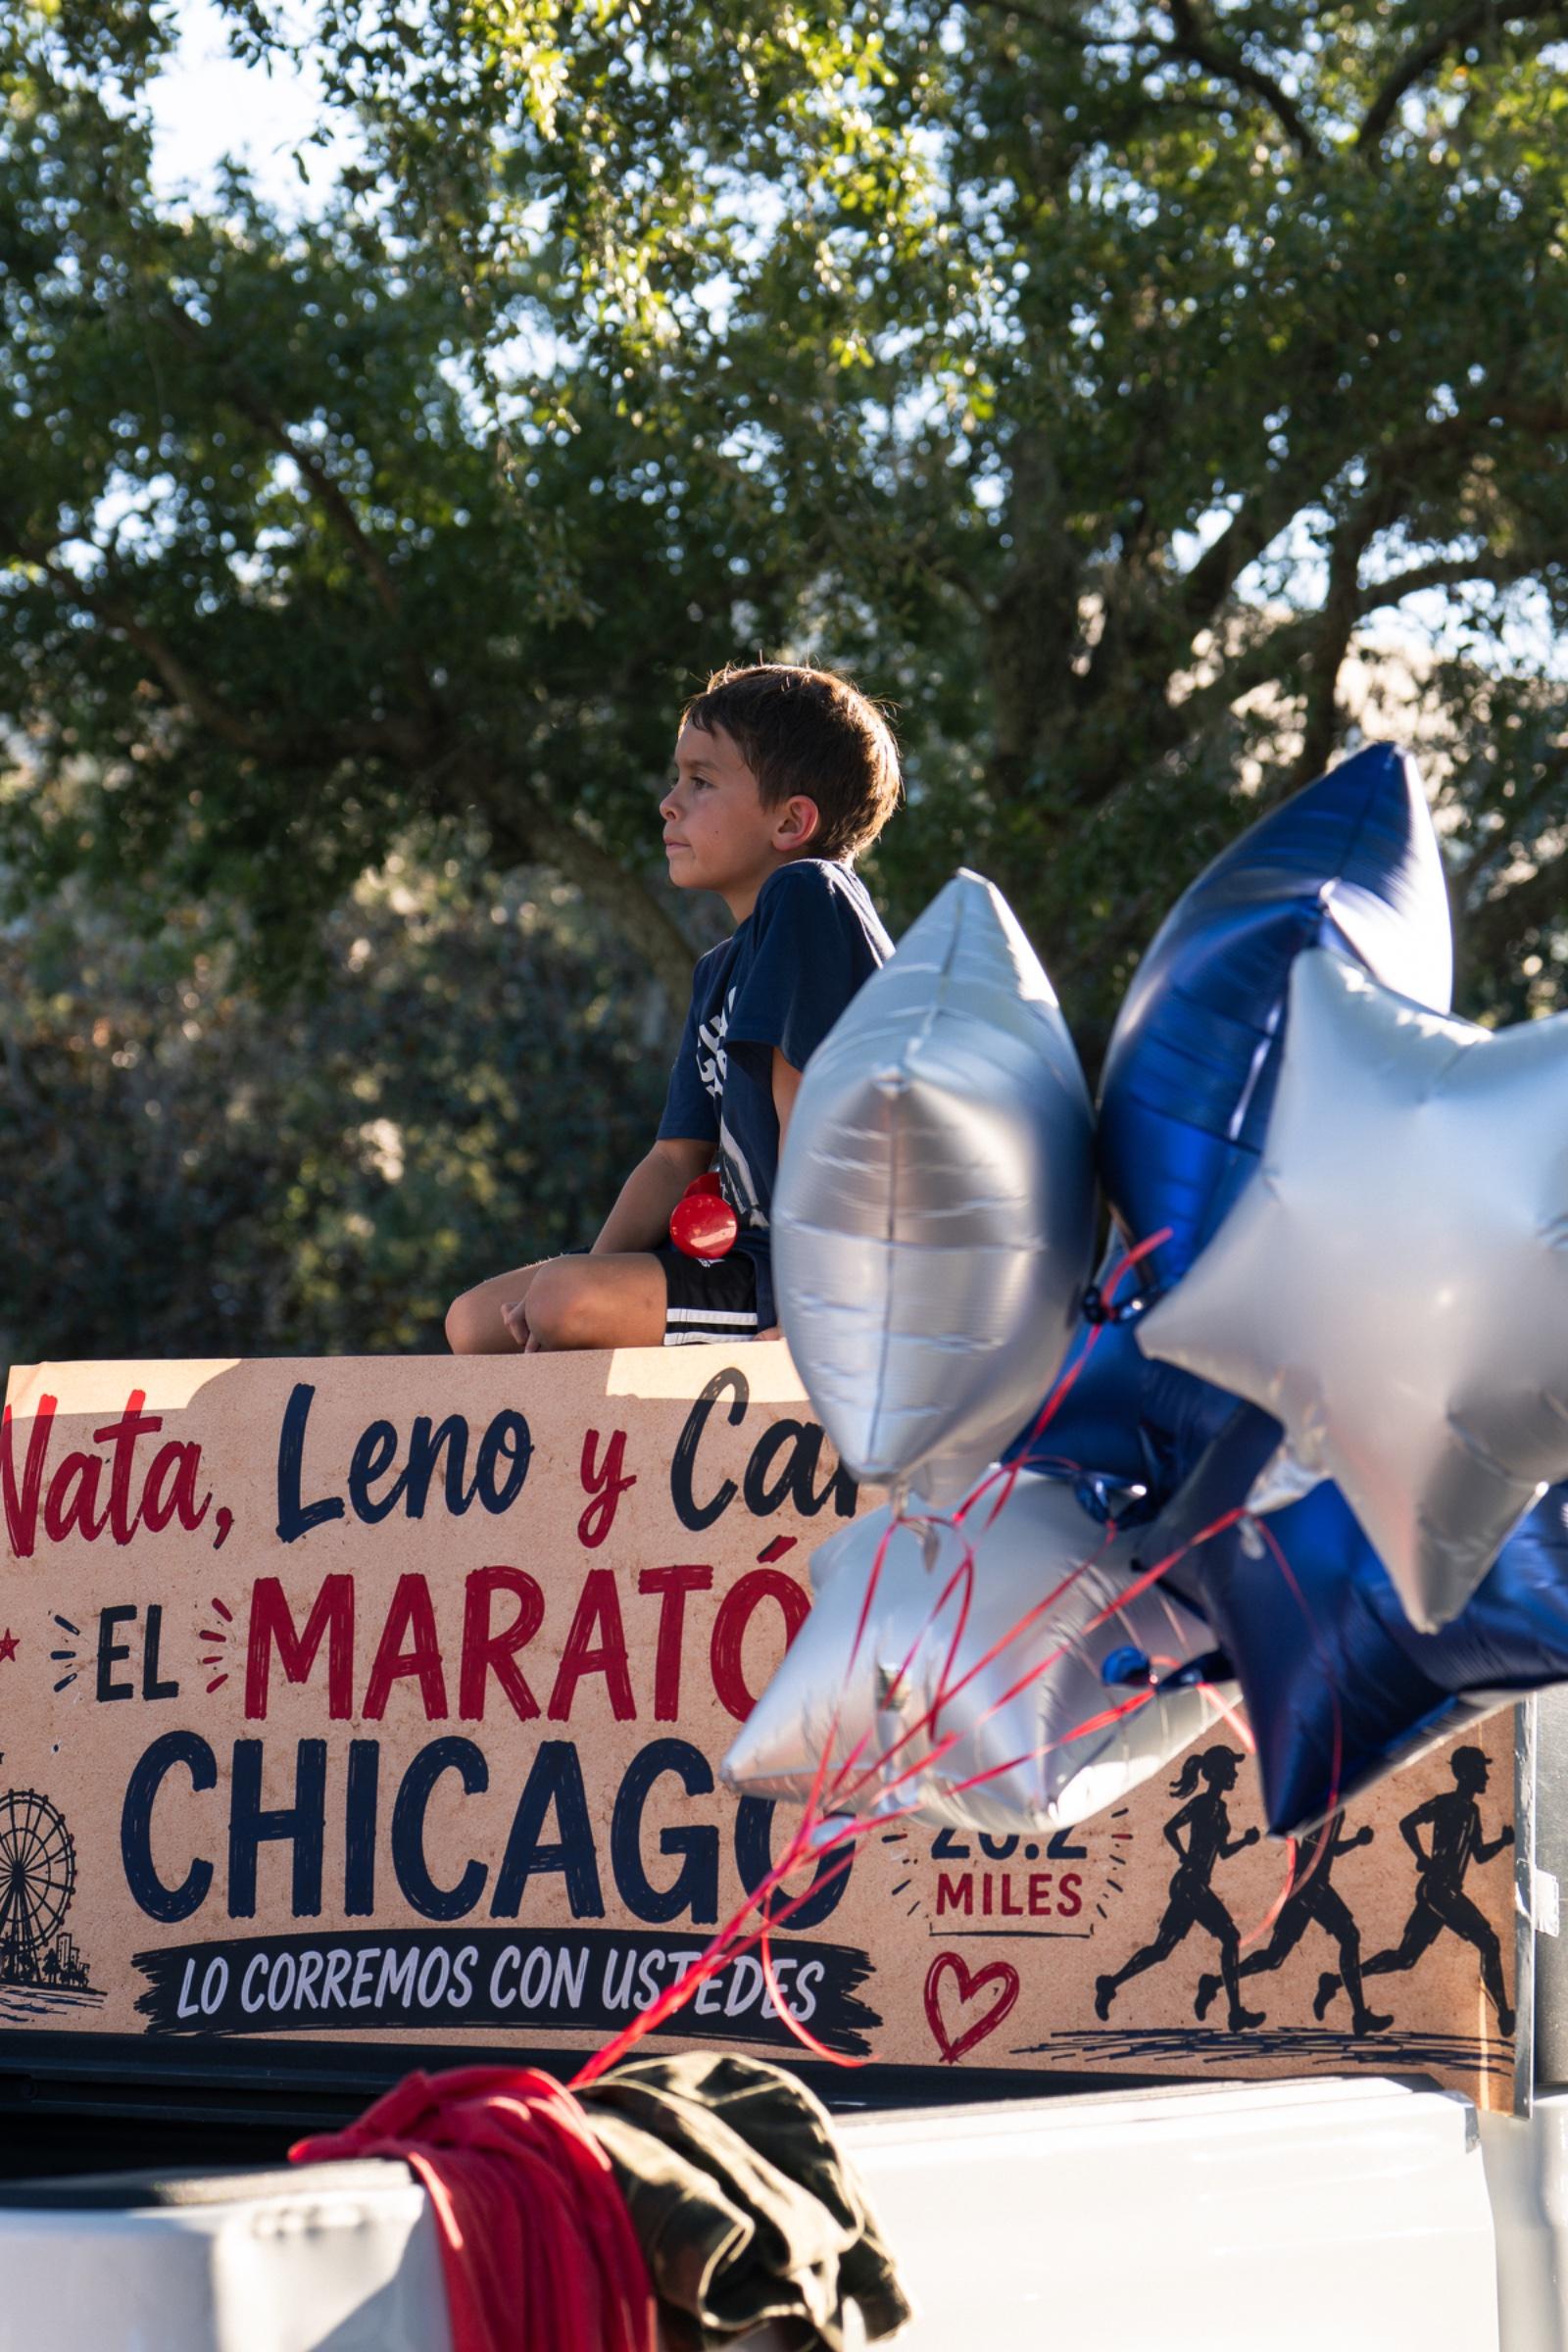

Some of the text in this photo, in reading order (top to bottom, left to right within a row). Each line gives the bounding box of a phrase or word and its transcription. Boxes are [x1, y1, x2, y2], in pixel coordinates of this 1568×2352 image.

[275, 1383, 535, 1543] Leno
[578, 1429, 636, 1548] y
[96, 1535, 811, 1723] EL MARATÓ
[121, 1730, 857, 1931] CHICAGO
[936, 1873, 1083, 1917] MILES
[176, 1945, 826, 2022] LO CORREMOS CON USTEDES
